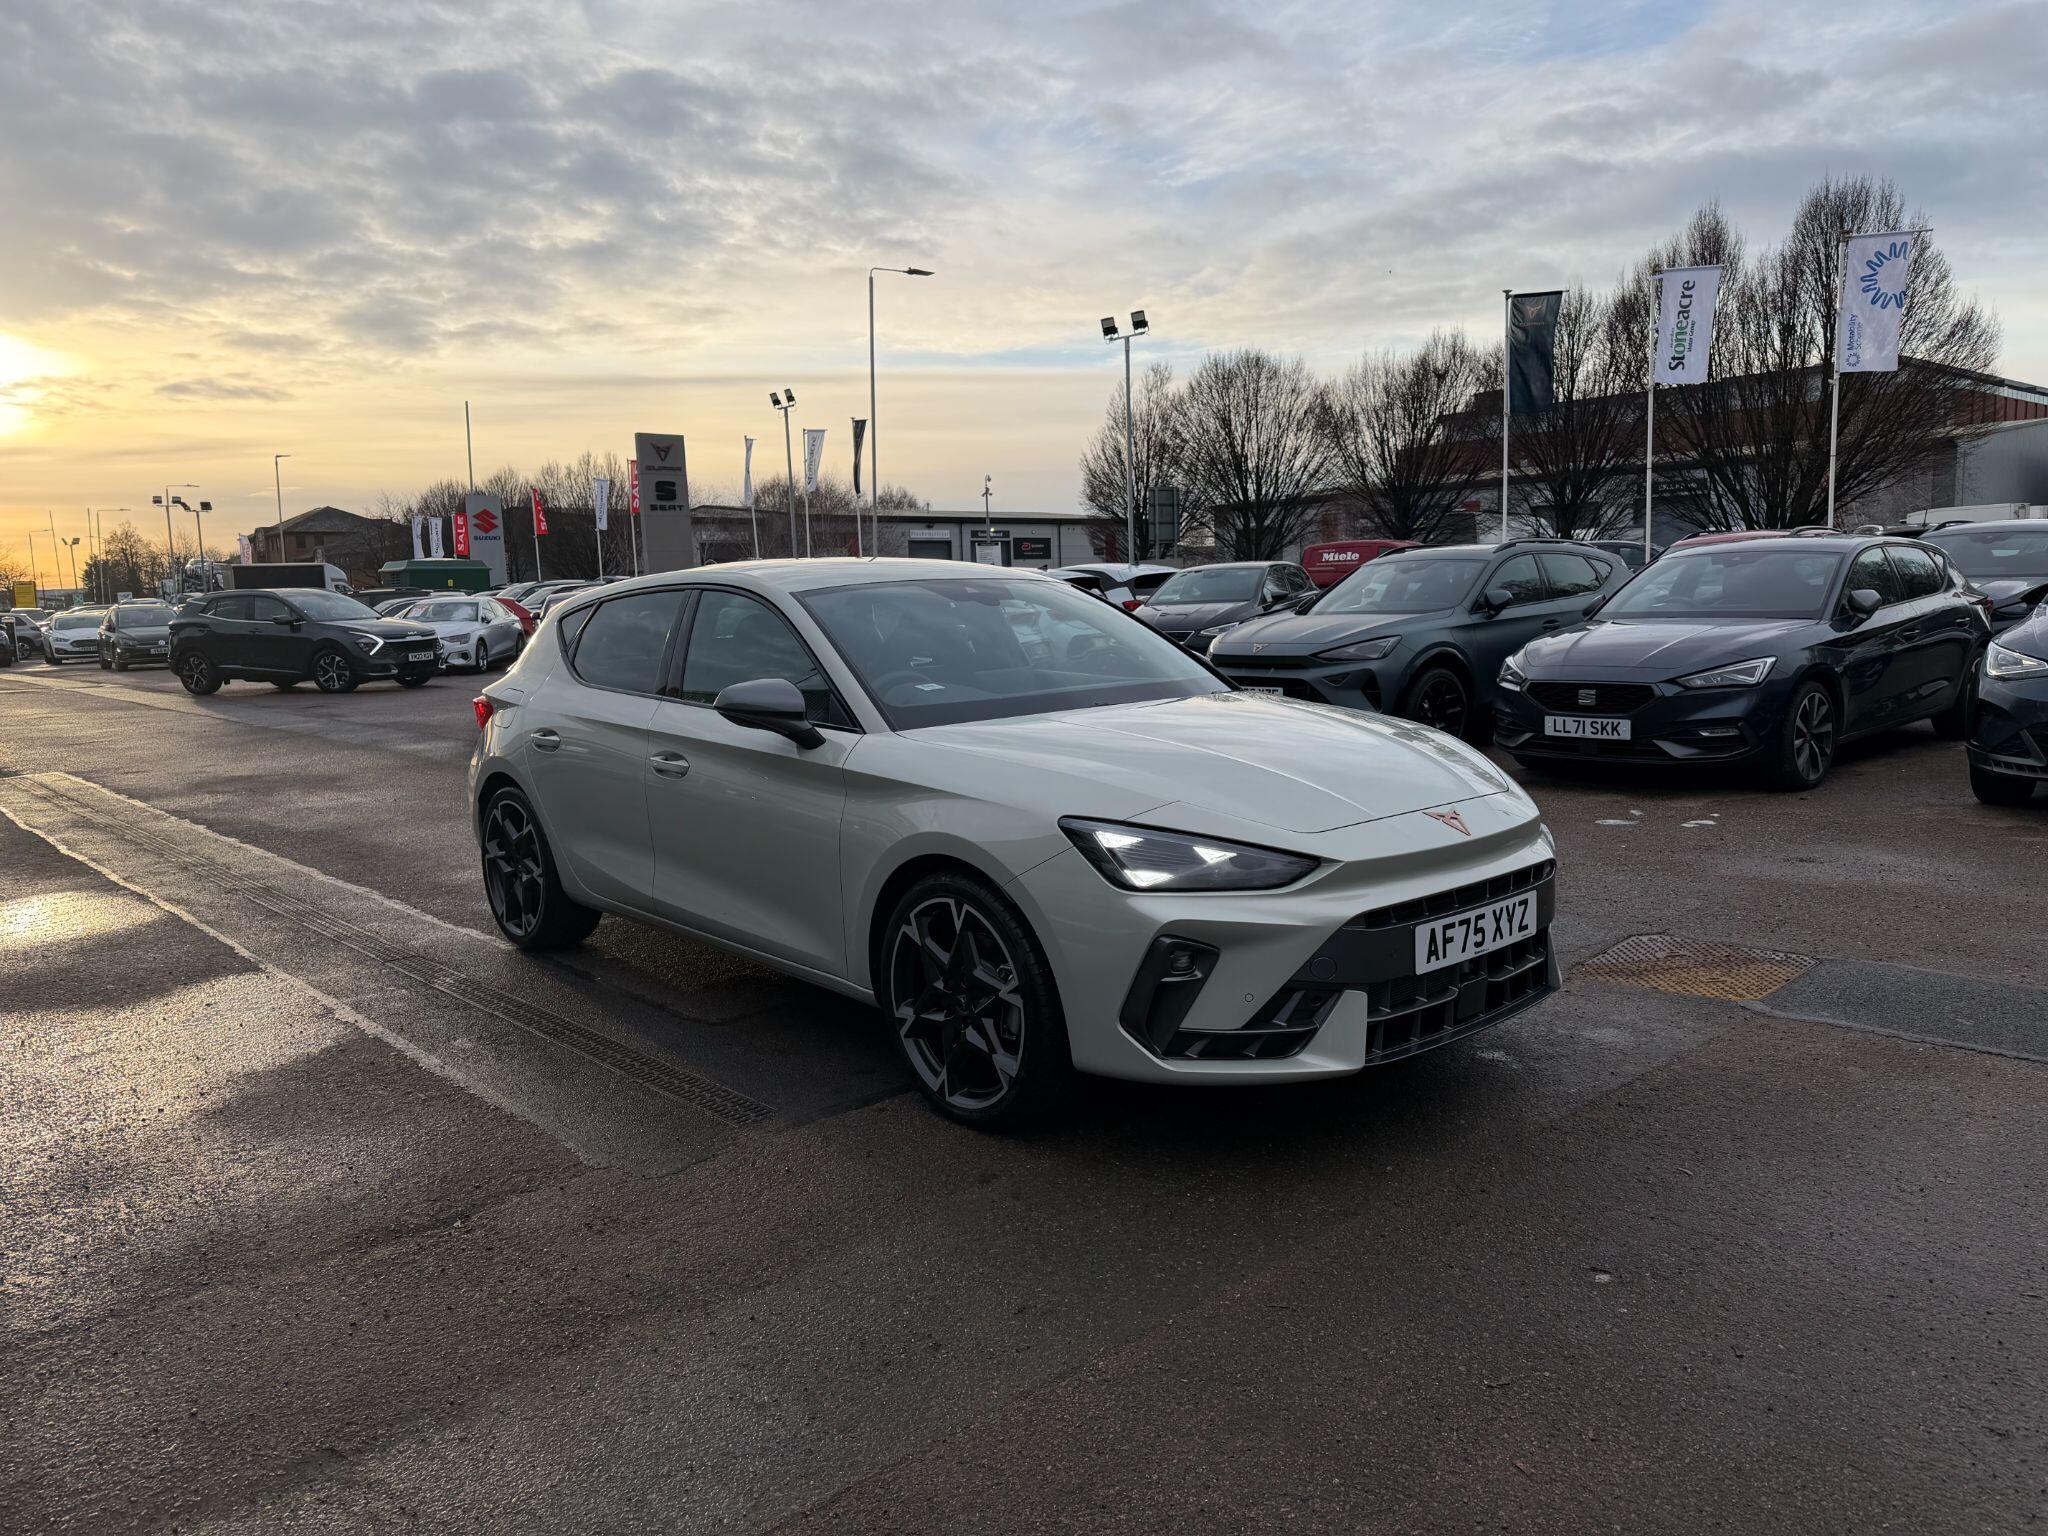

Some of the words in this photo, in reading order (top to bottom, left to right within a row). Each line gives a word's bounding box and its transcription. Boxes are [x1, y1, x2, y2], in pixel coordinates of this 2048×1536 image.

[1668, 280, 1696, 371] Stoneacre
[1846, 313, 1858, 351] Motability
[457, 516, 465, 551] SALE
[1321, 551, 1360, 562] Miele
[1553, 718, 1586, 734] LL71
[1590, 720, 1621, 736] SKK
[1426, 913, 1486, 964] AF75
[1492, 898, 1529, 942] XYZ
